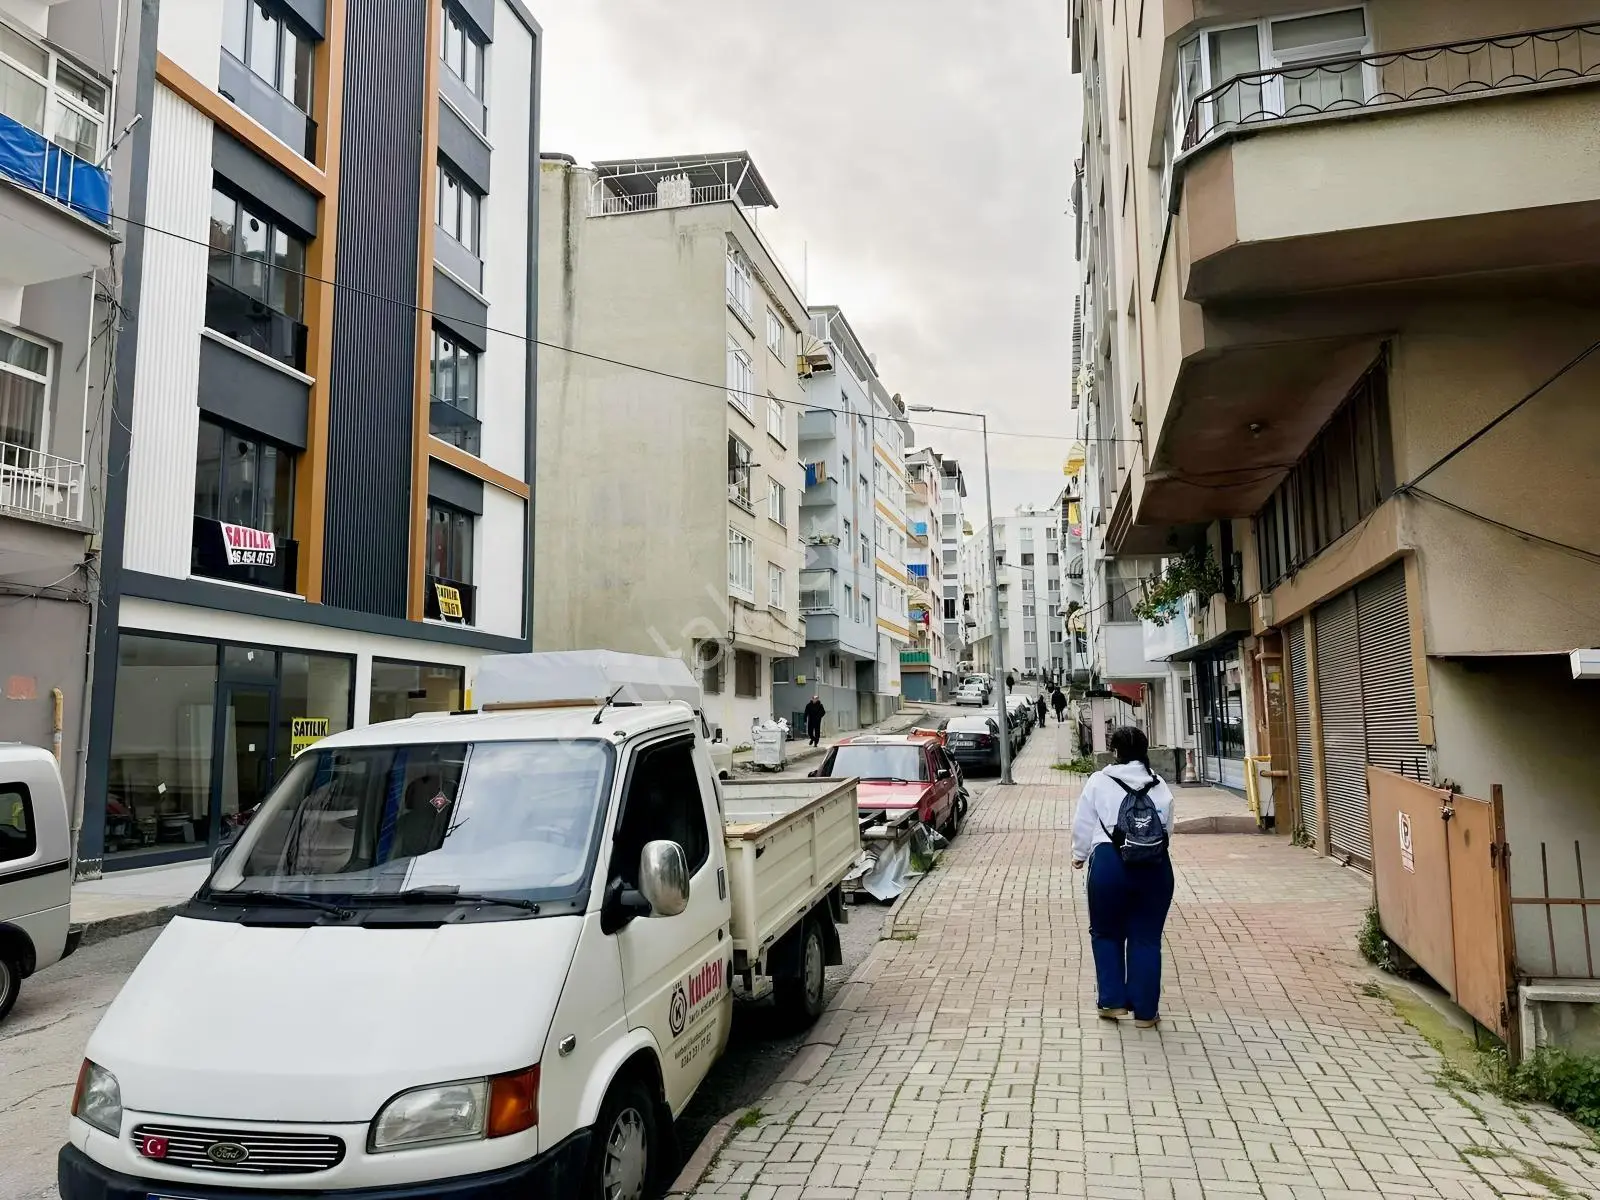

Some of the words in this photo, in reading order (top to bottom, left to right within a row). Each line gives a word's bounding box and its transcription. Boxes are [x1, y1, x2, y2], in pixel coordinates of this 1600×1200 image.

[225, 526, 271, 549] SATILIK
[294, 721, 327, 737] SATILIK
[688, 958, 723, 1009] kutbay
[215, 1147, 239, 1159] Ford
